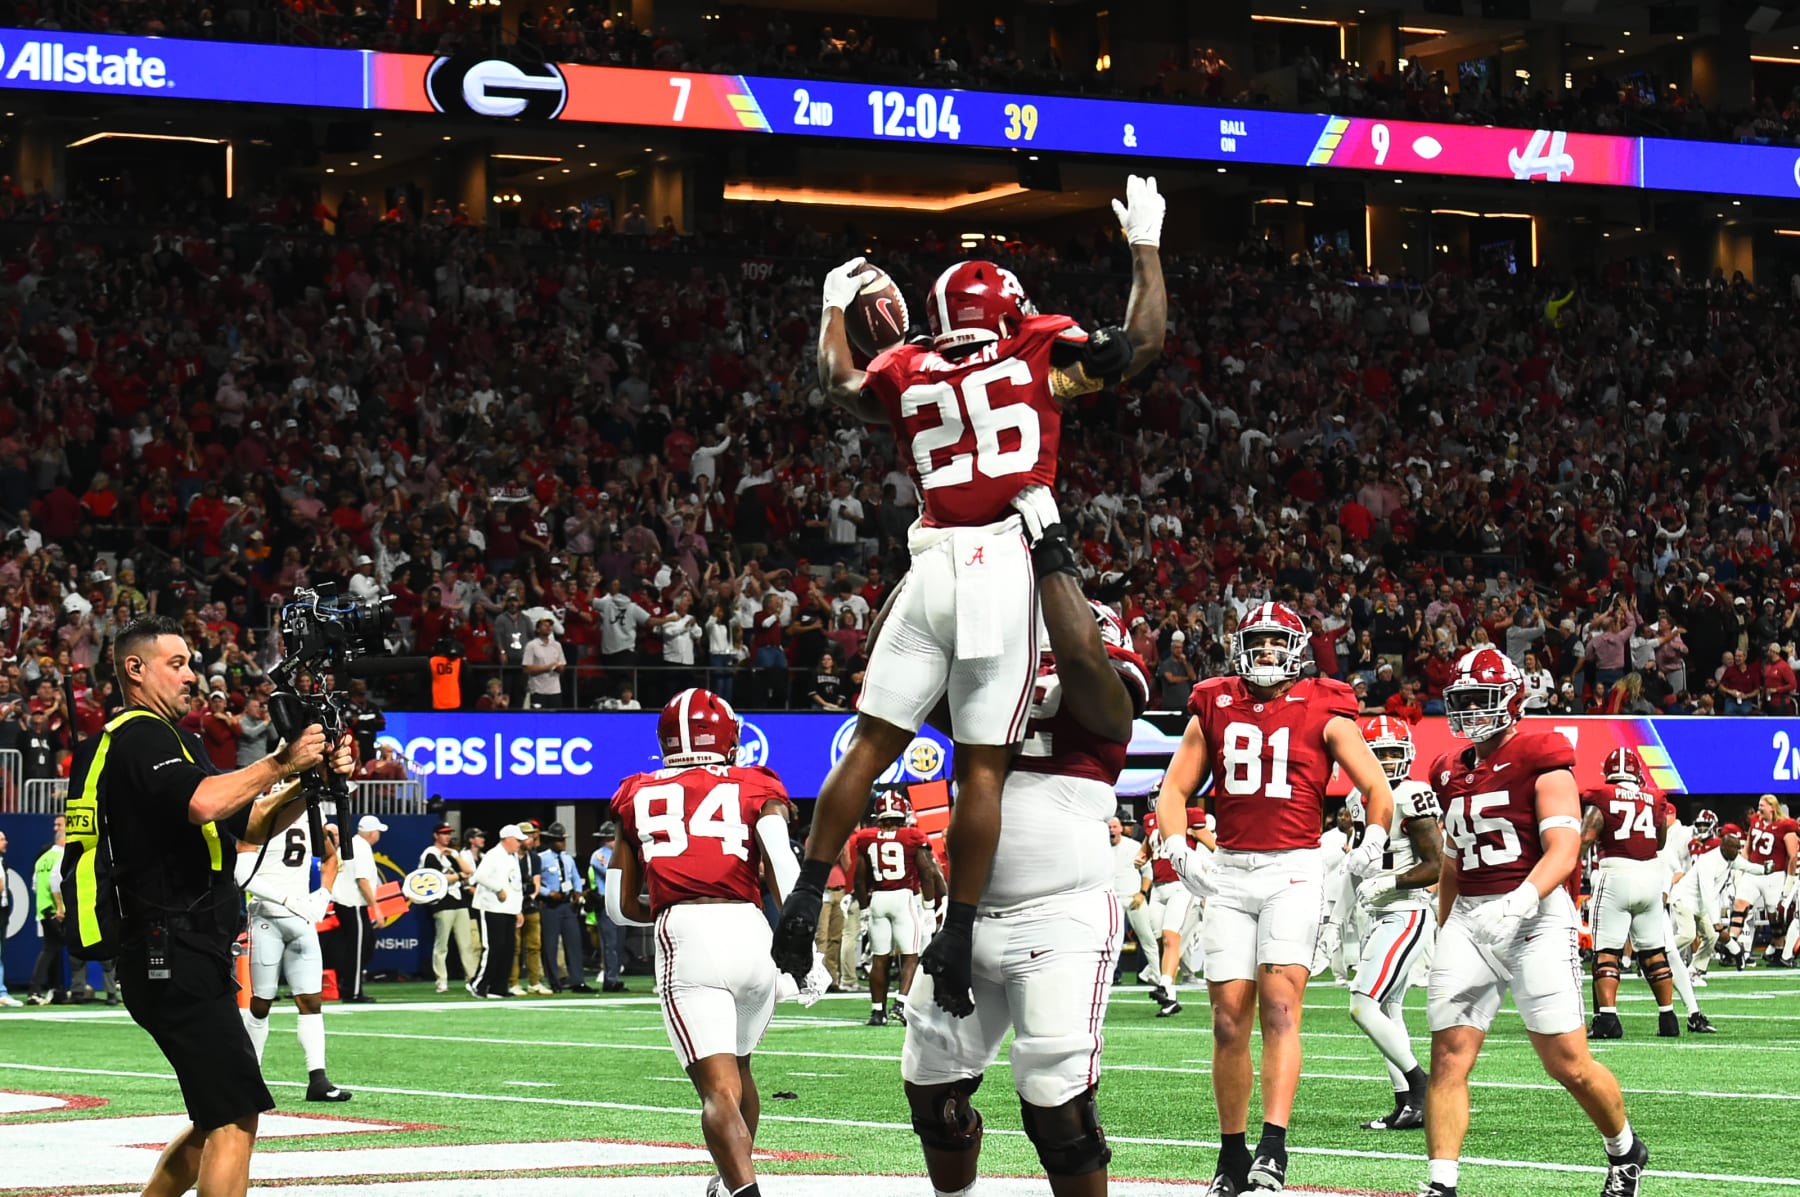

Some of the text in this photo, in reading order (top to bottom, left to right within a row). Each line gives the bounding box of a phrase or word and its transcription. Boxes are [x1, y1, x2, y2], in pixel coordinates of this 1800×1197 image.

[6, 41, 167, 89] Allstate
[669, 78, 691, 122] 7
[793, 89, 1138, 148] 2ND 12:04 39 &
[1220, 119, 1247, 137] BALL
[1220, 138, 1236, 153] ON
[1371, 124, 1390, 165] 9
[901, 357, 1041, 490] 26
[964, 546, 984, 566] A
[1566, 553, 1575, 569] 3
[1530, 675, 1541, 690] 9
[405, 736, 593, 776] CBS SEC
[1223, 721, 1292, 799] 81
[1411, 791, 1436, 814] 22
[1615, 787, 1655, 806] PROCTOR
[633, 782, 749, 863] 84
[1444, 790, 1522, 872] 45
[1609, 800, 1657, 840] 74
[282, 828, 306, 868] 6
[867, 841, 906, 881] 19
[1751, 828, 1785, 856] 73
